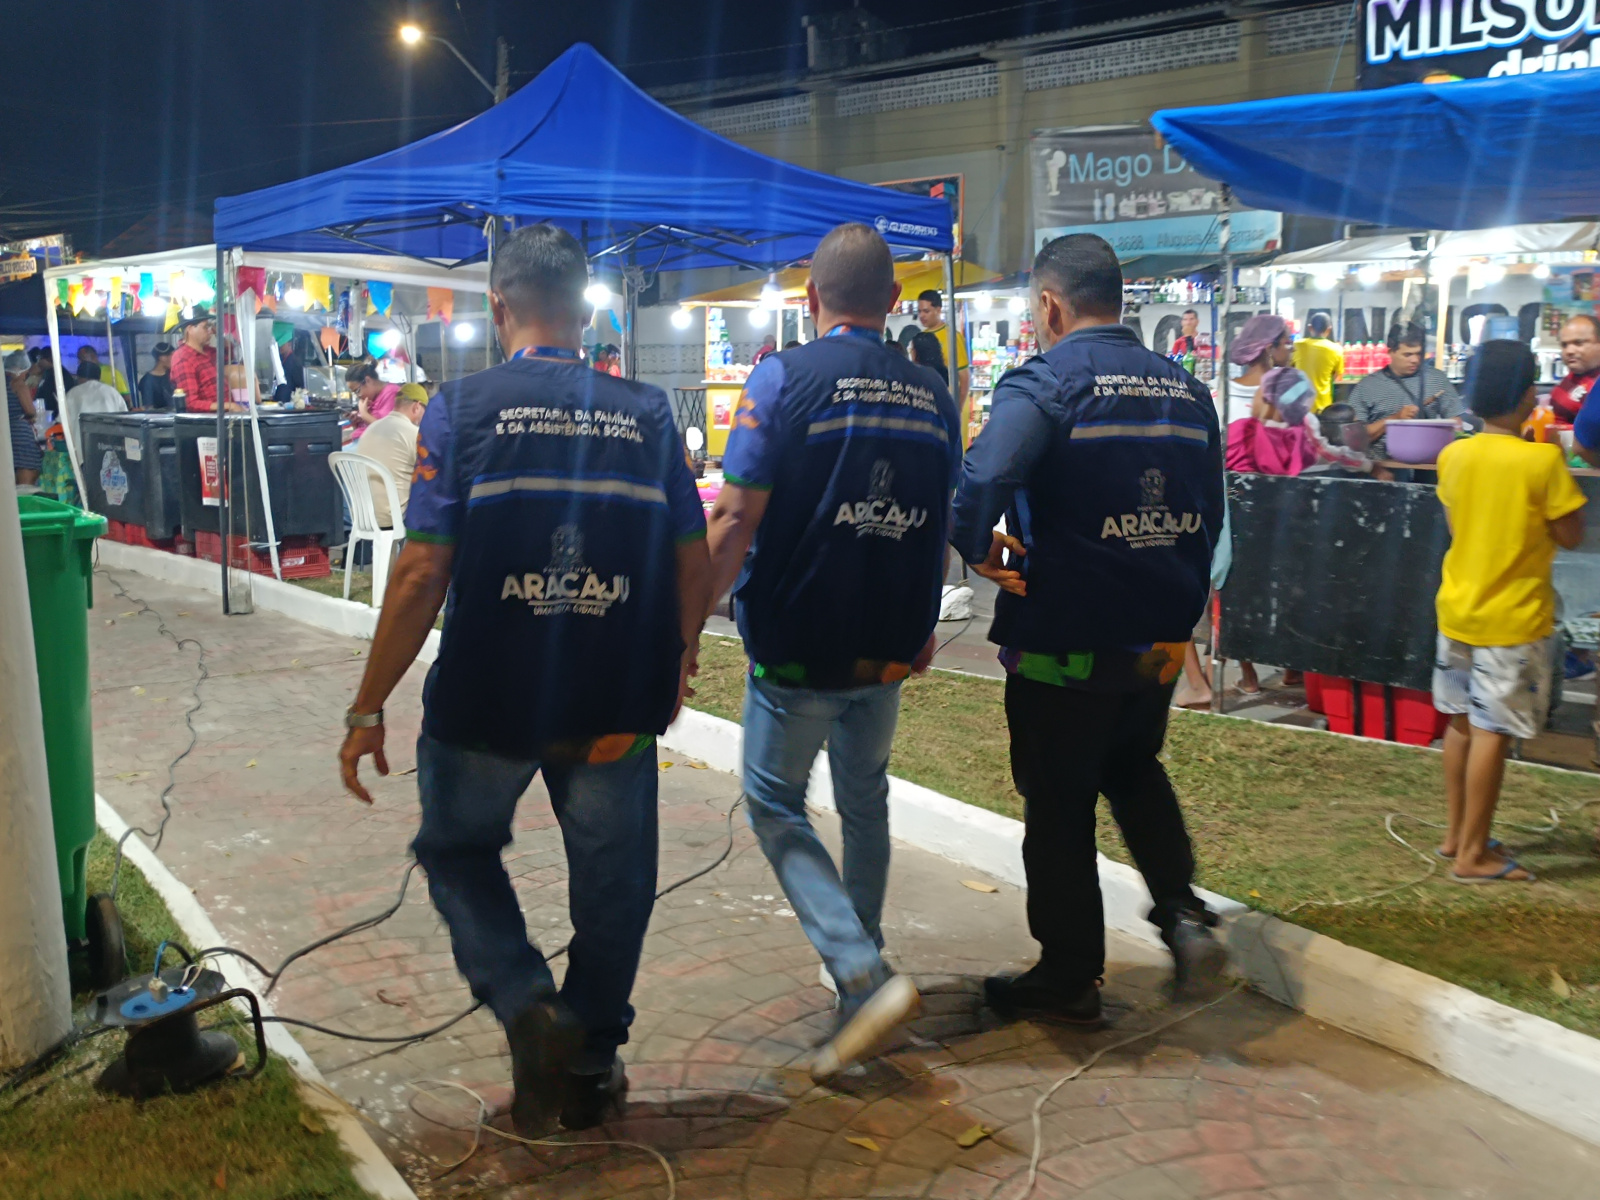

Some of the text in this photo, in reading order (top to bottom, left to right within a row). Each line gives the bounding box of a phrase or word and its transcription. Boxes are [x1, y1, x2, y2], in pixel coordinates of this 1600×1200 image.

[1367, 0, 1600, 63] MILSO
[1069, 151, 1152, 187] Mago
[891, 381, 904, 392] DA
[1094, 374, 1146, 386] SECRETARIA
[1147, 376, 1160, 387] DA
[842, 389, 857, 401] DA
[1102, 386, 1117, 397] DA
[1169, 387, 1196, 402] SOCIAL
[499, 407, 571, 421] SECRETARIA
[574, 409, 592, 421] DA
[495, 422, 506, 435] E
[507, 421, 526, 435] DA
[603, 423, 644, 443] SOCIAL
[832, 500, 928, 528] ARCAJU
[1100, 512, 1202, 540] ARACAJU
[500, 573, 631, 604] ARACAJU
